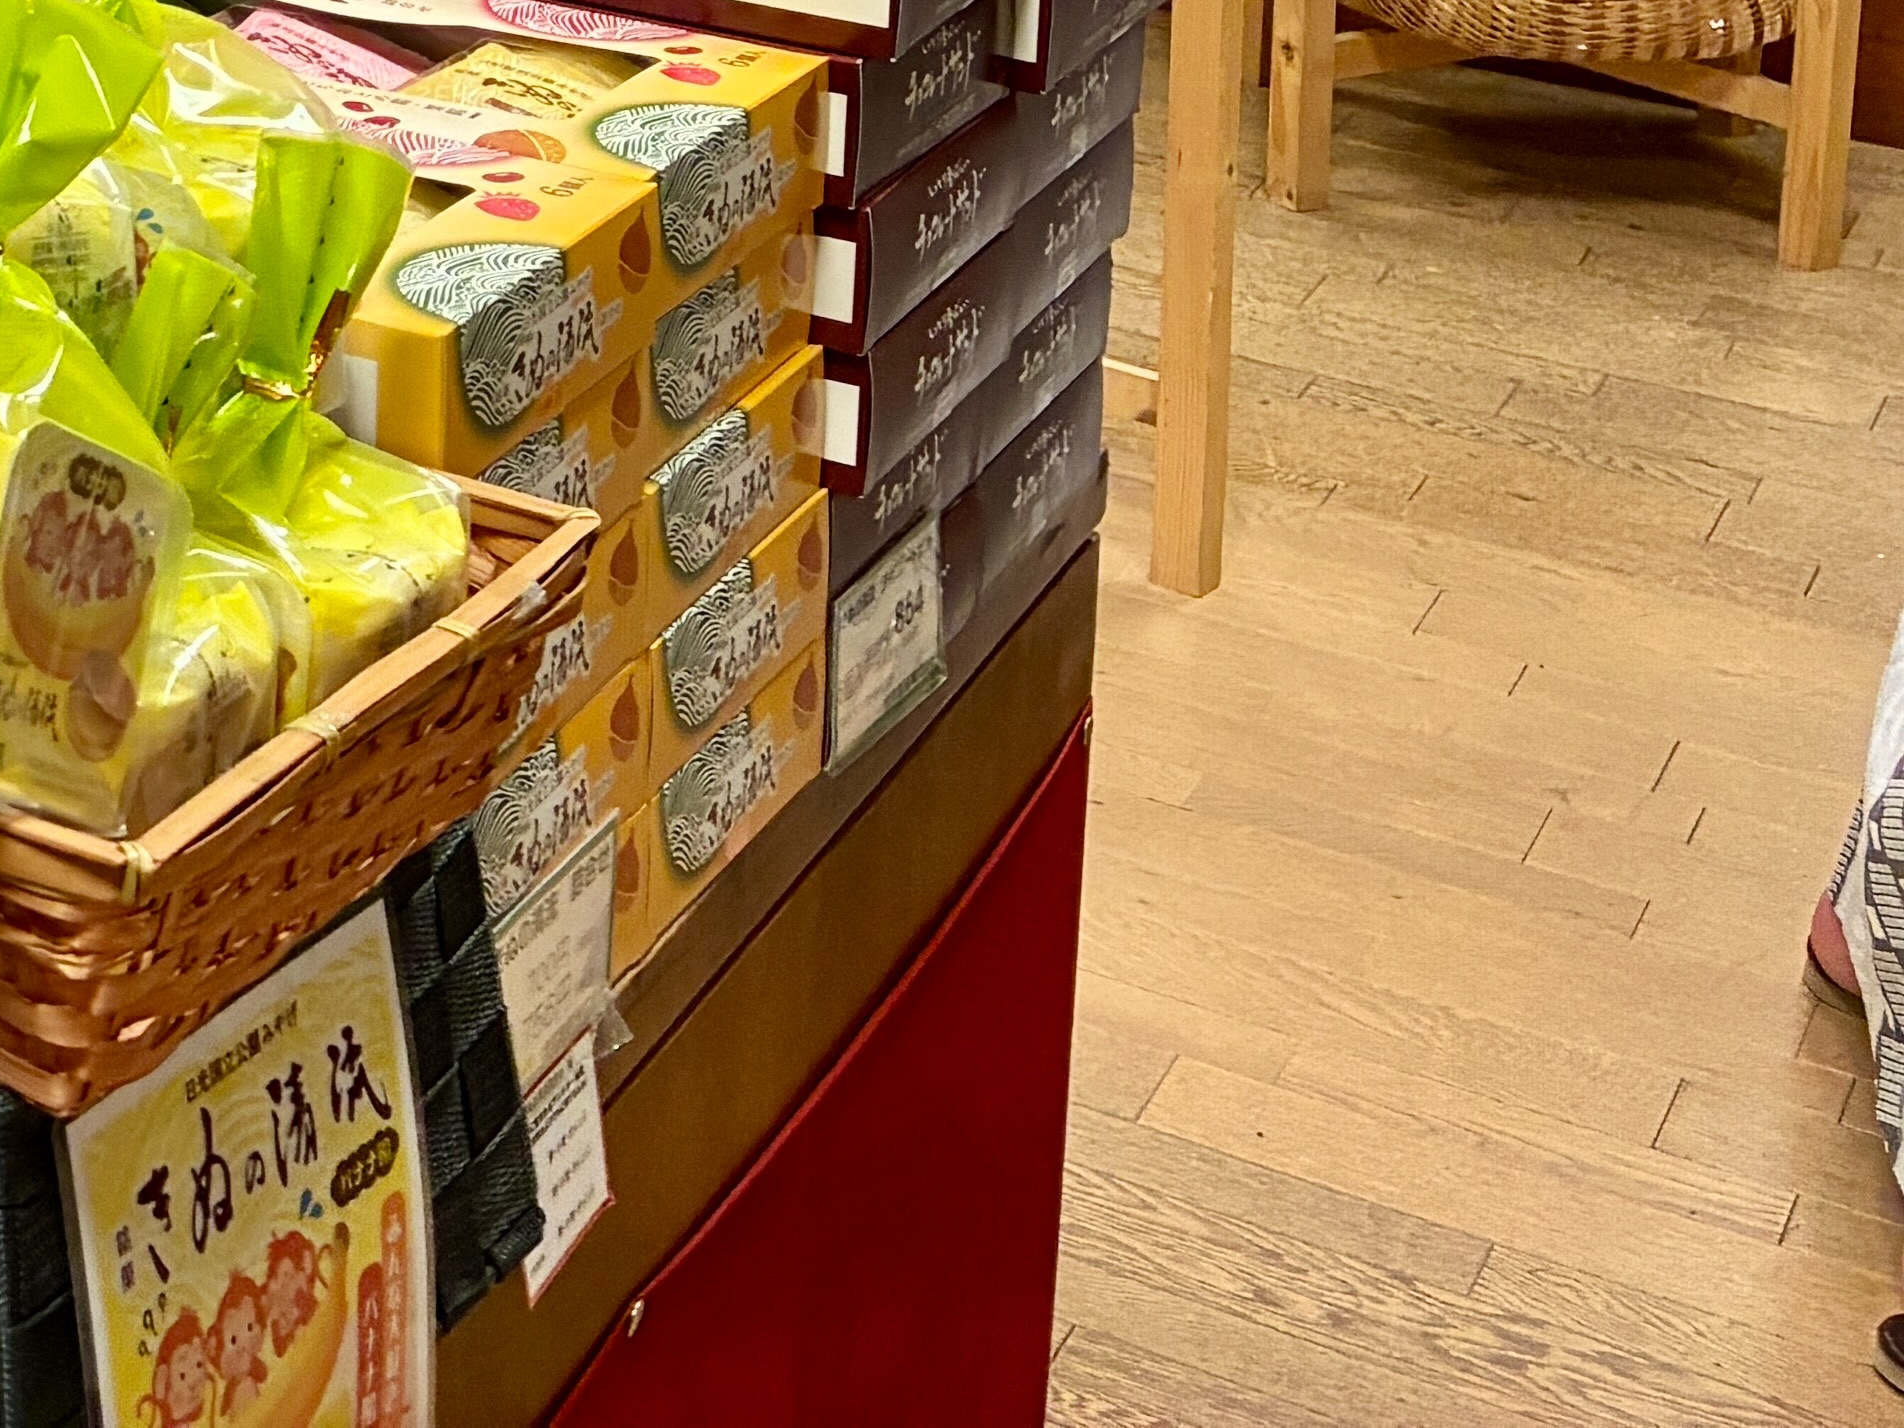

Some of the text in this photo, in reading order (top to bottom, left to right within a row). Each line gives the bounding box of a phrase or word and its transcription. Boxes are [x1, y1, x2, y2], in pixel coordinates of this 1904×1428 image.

[135, 1024, 394, 1284] きぬの清流
